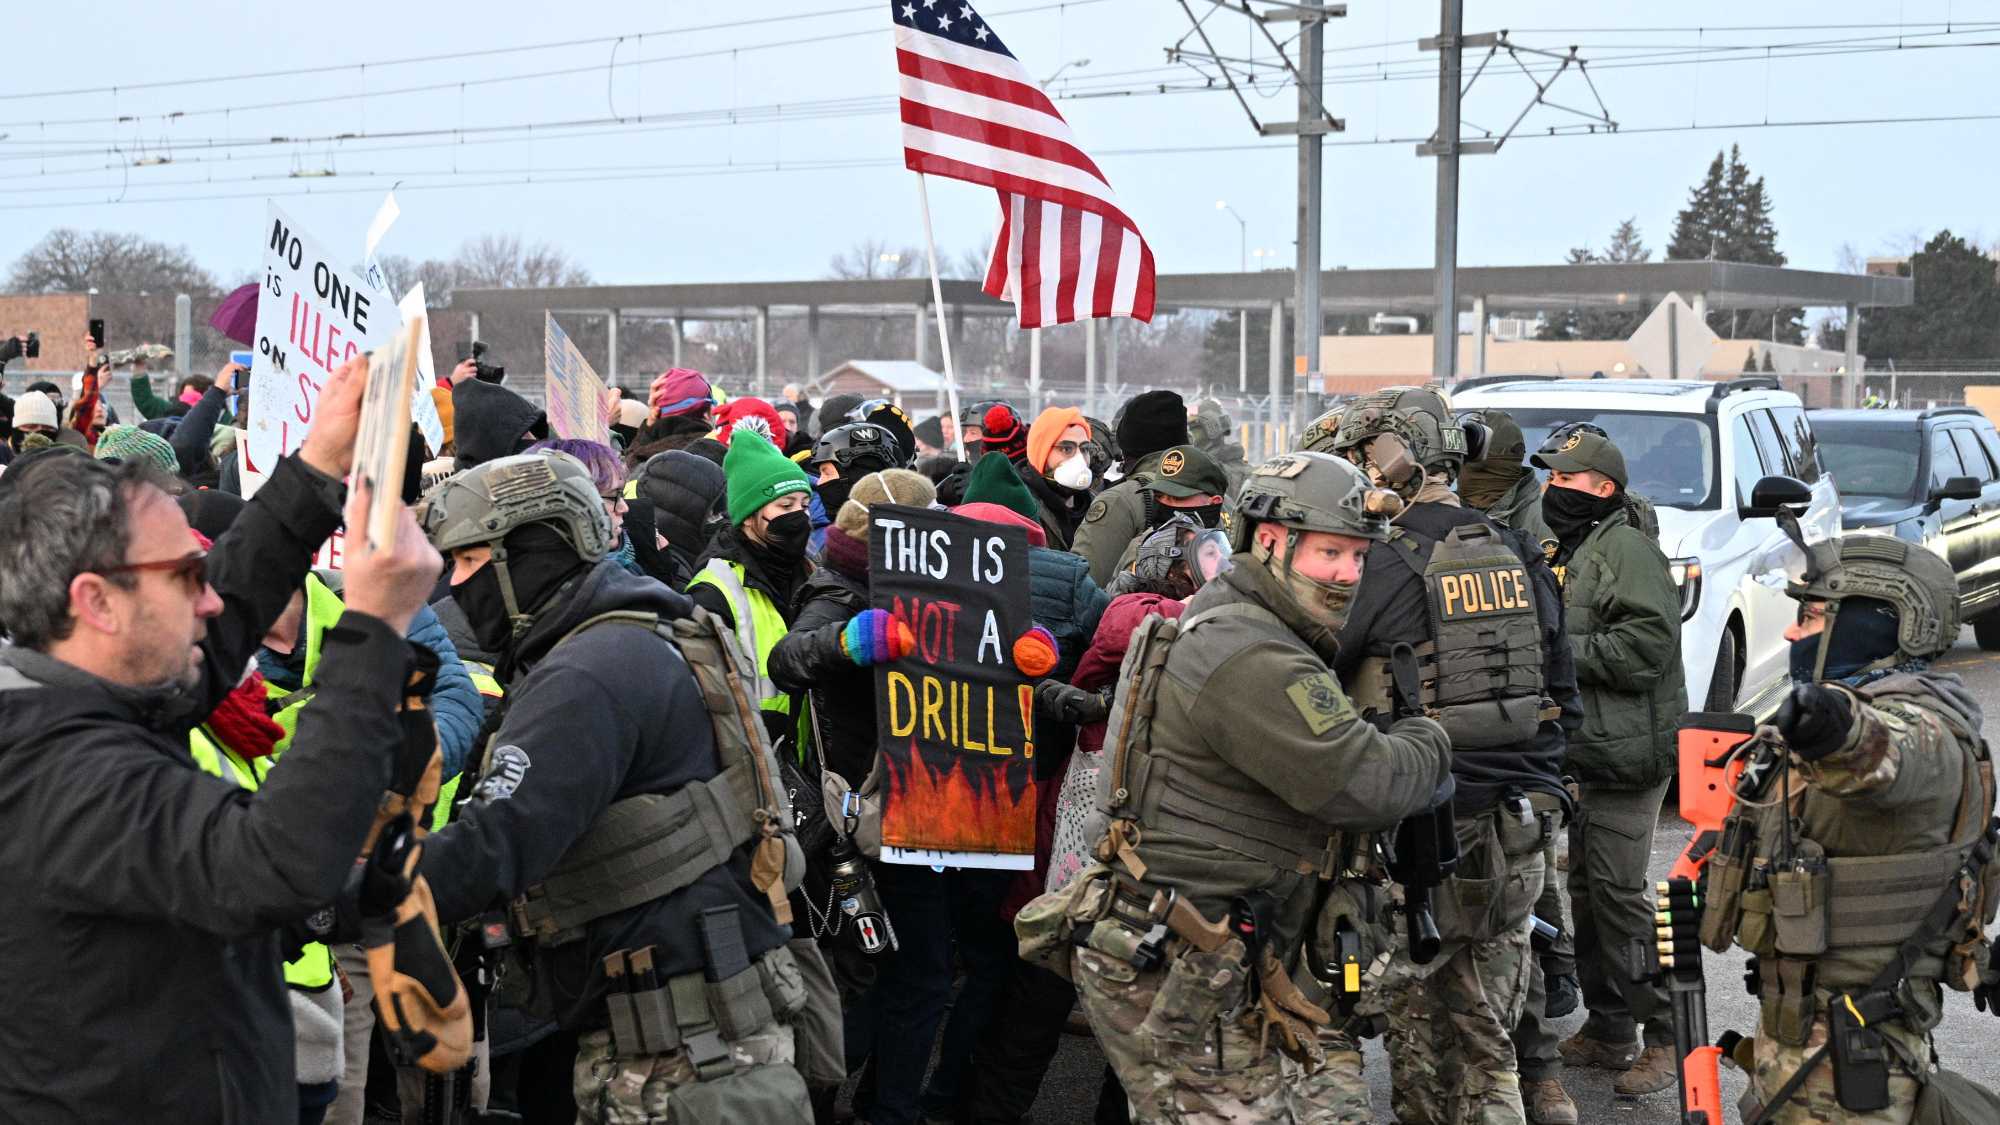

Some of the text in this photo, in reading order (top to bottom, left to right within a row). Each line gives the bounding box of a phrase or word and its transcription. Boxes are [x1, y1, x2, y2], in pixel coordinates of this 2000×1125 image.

[266, 266, 282, 297] is
[270, 218, 370, 335] NO ONE
[260, 336, 286, 370] ON
[875, 518, 1006, 584] THIS IS
[1441, 569, 1529, 615] POLICE
[893, 595, 1003, 664] NOT A
[1301, 675, 1323, 690] ICE
[887, 671, 1034, 758] DRILL!
